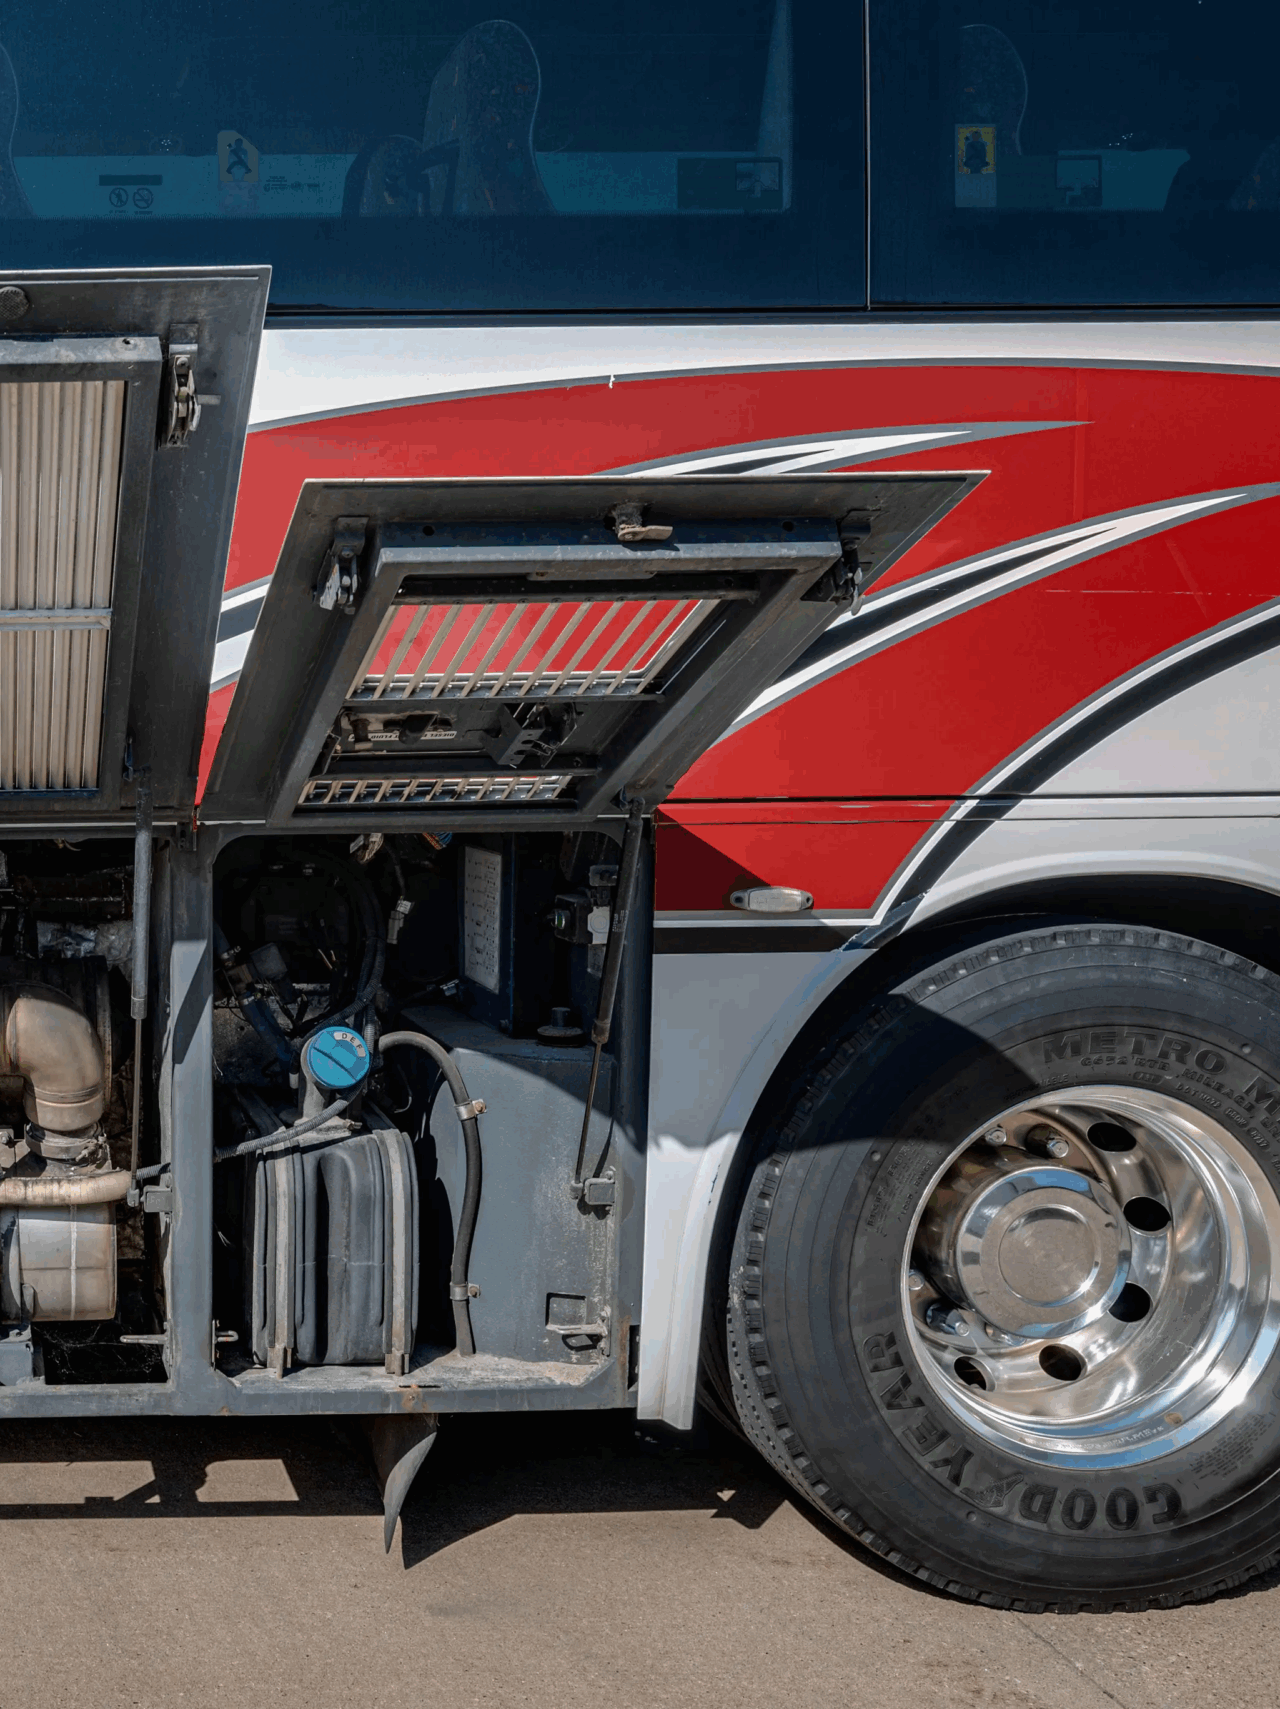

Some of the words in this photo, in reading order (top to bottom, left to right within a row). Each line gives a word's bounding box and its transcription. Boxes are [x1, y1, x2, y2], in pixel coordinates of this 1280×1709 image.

[341, 1032, 364, 1049] DEF
[1041, 1030, 1227, 1075] METRO
[1175, 1081, 1200, 1097] DOT
[914, 1159, 934, 1188] RANGE
[862, 1330, 1183, 1532] GOODYEAR
